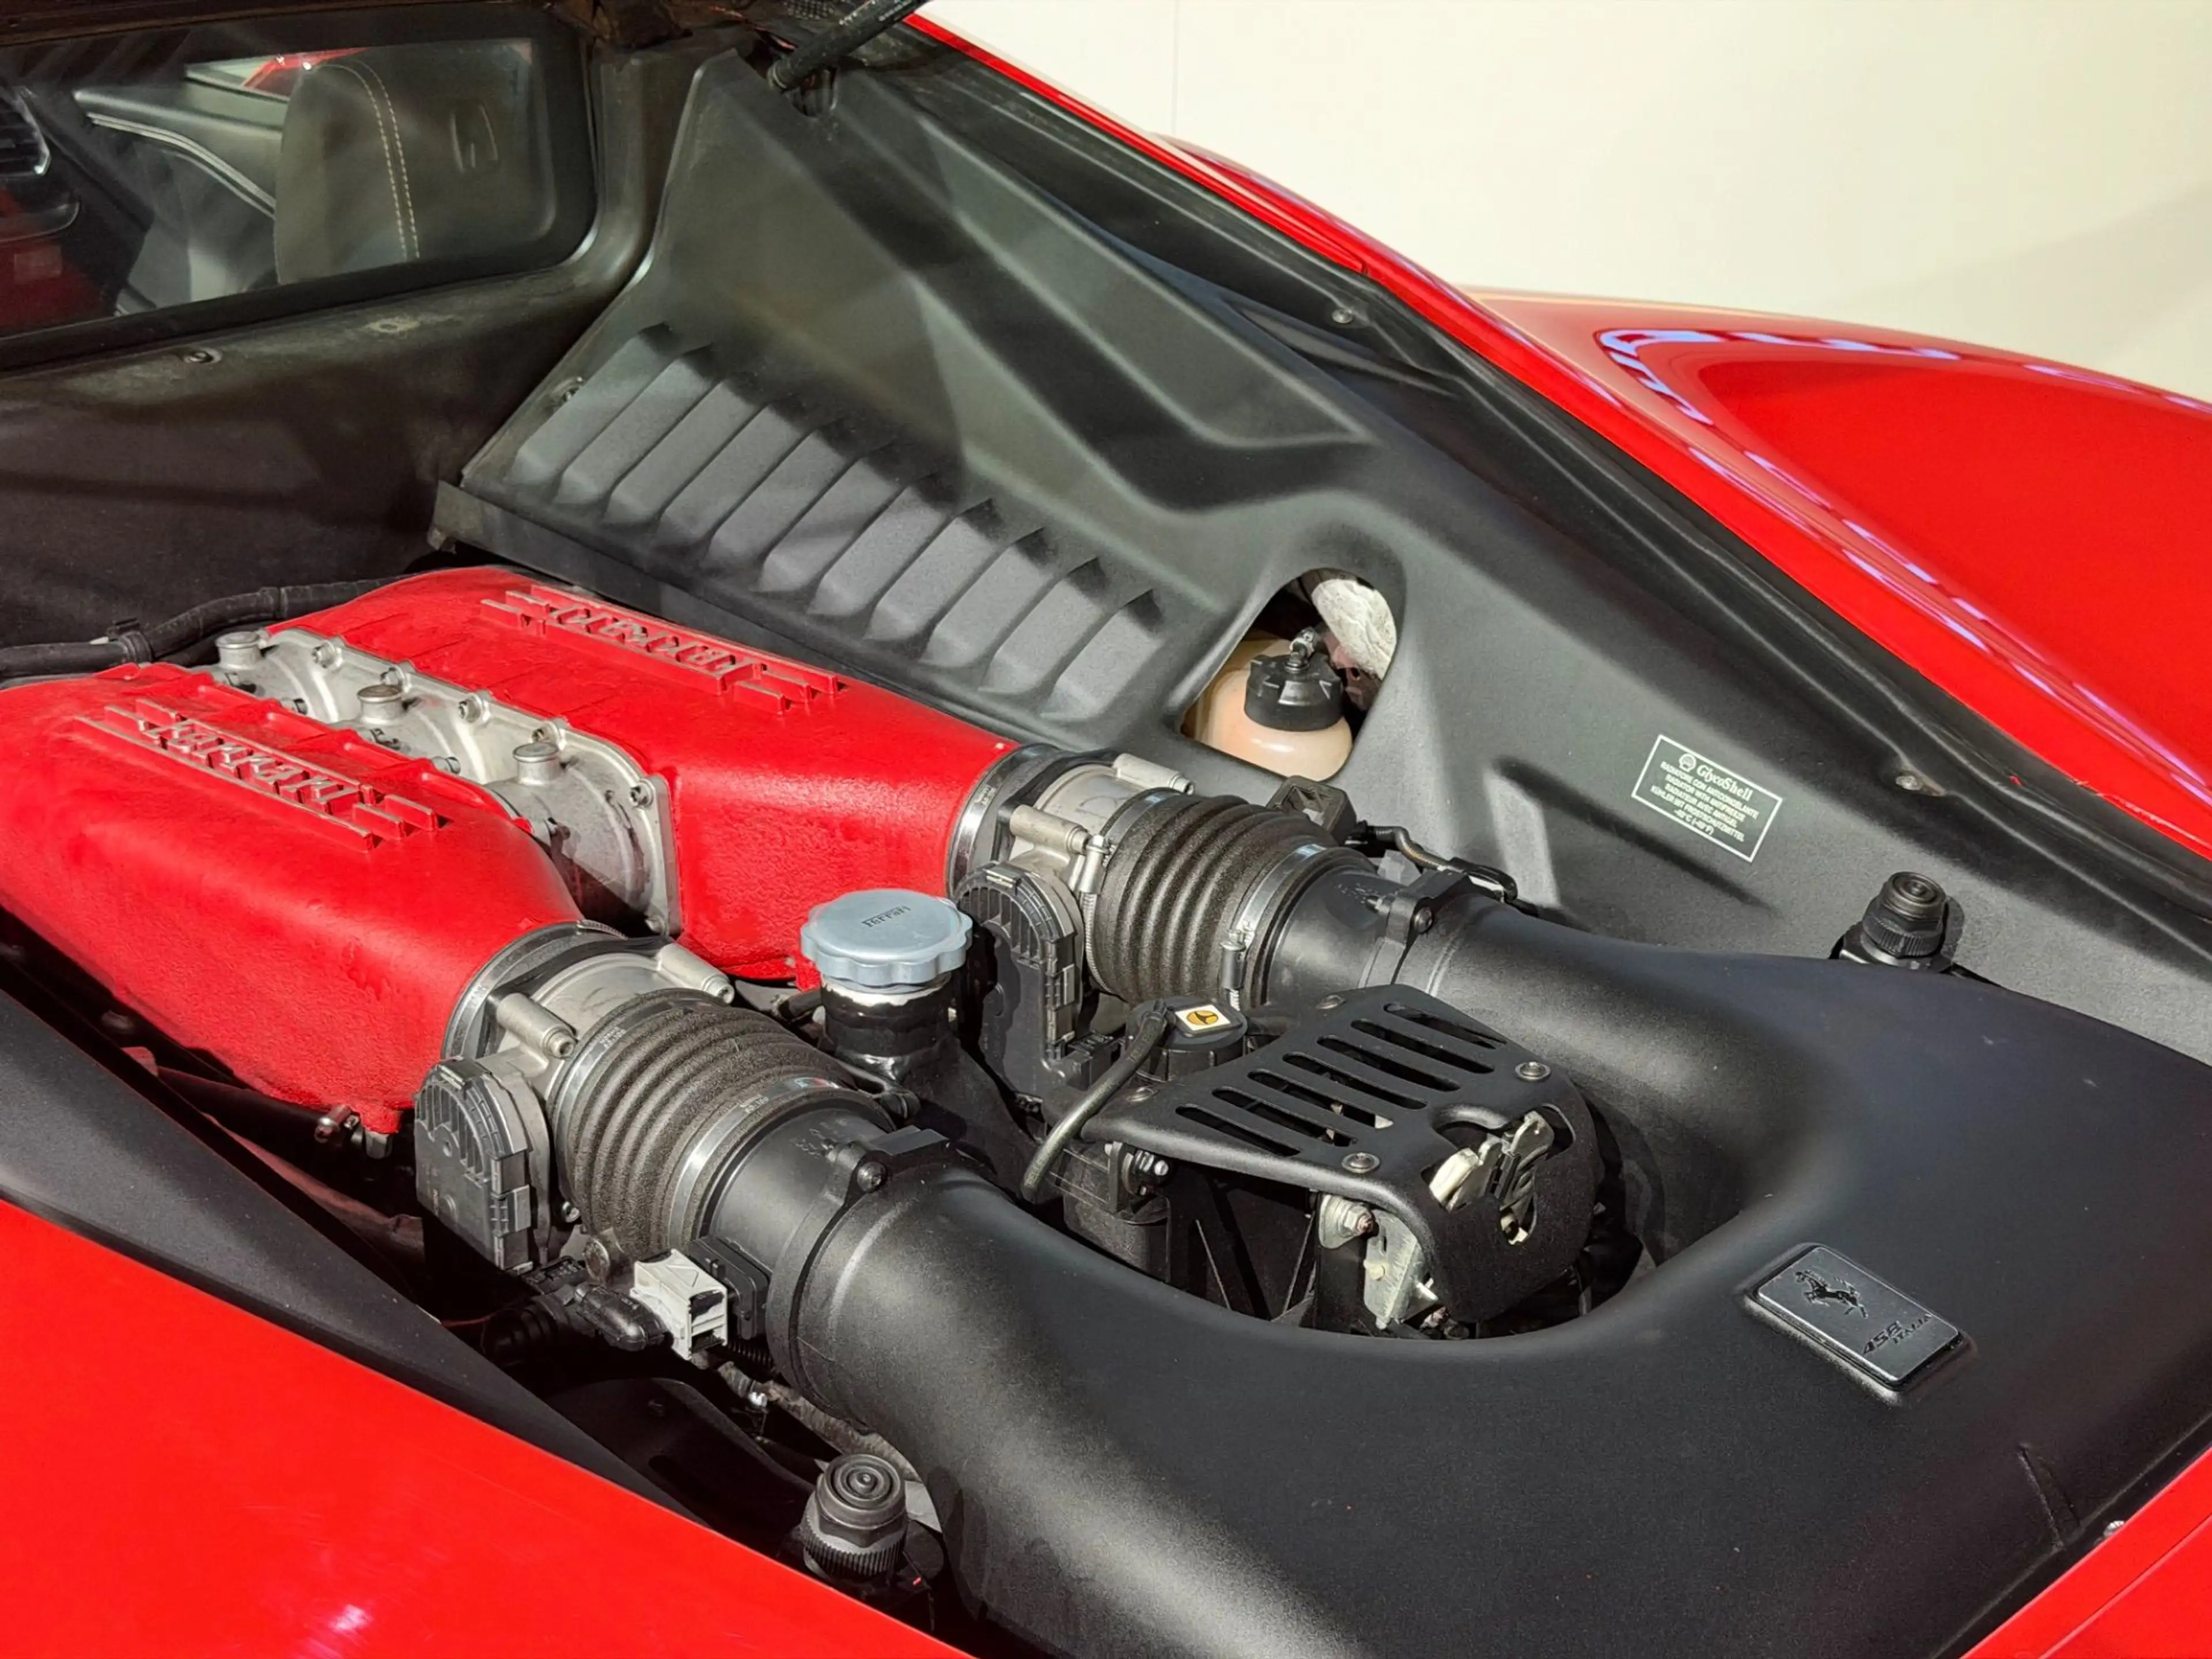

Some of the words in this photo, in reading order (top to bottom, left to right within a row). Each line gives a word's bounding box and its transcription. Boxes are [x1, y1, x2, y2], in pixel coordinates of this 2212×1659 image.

[1695, 763, 1753, 801] GlycoShell
[862, 905, 911, 927] Ferrari
[1861, 1320, 1902, 1356] 458
